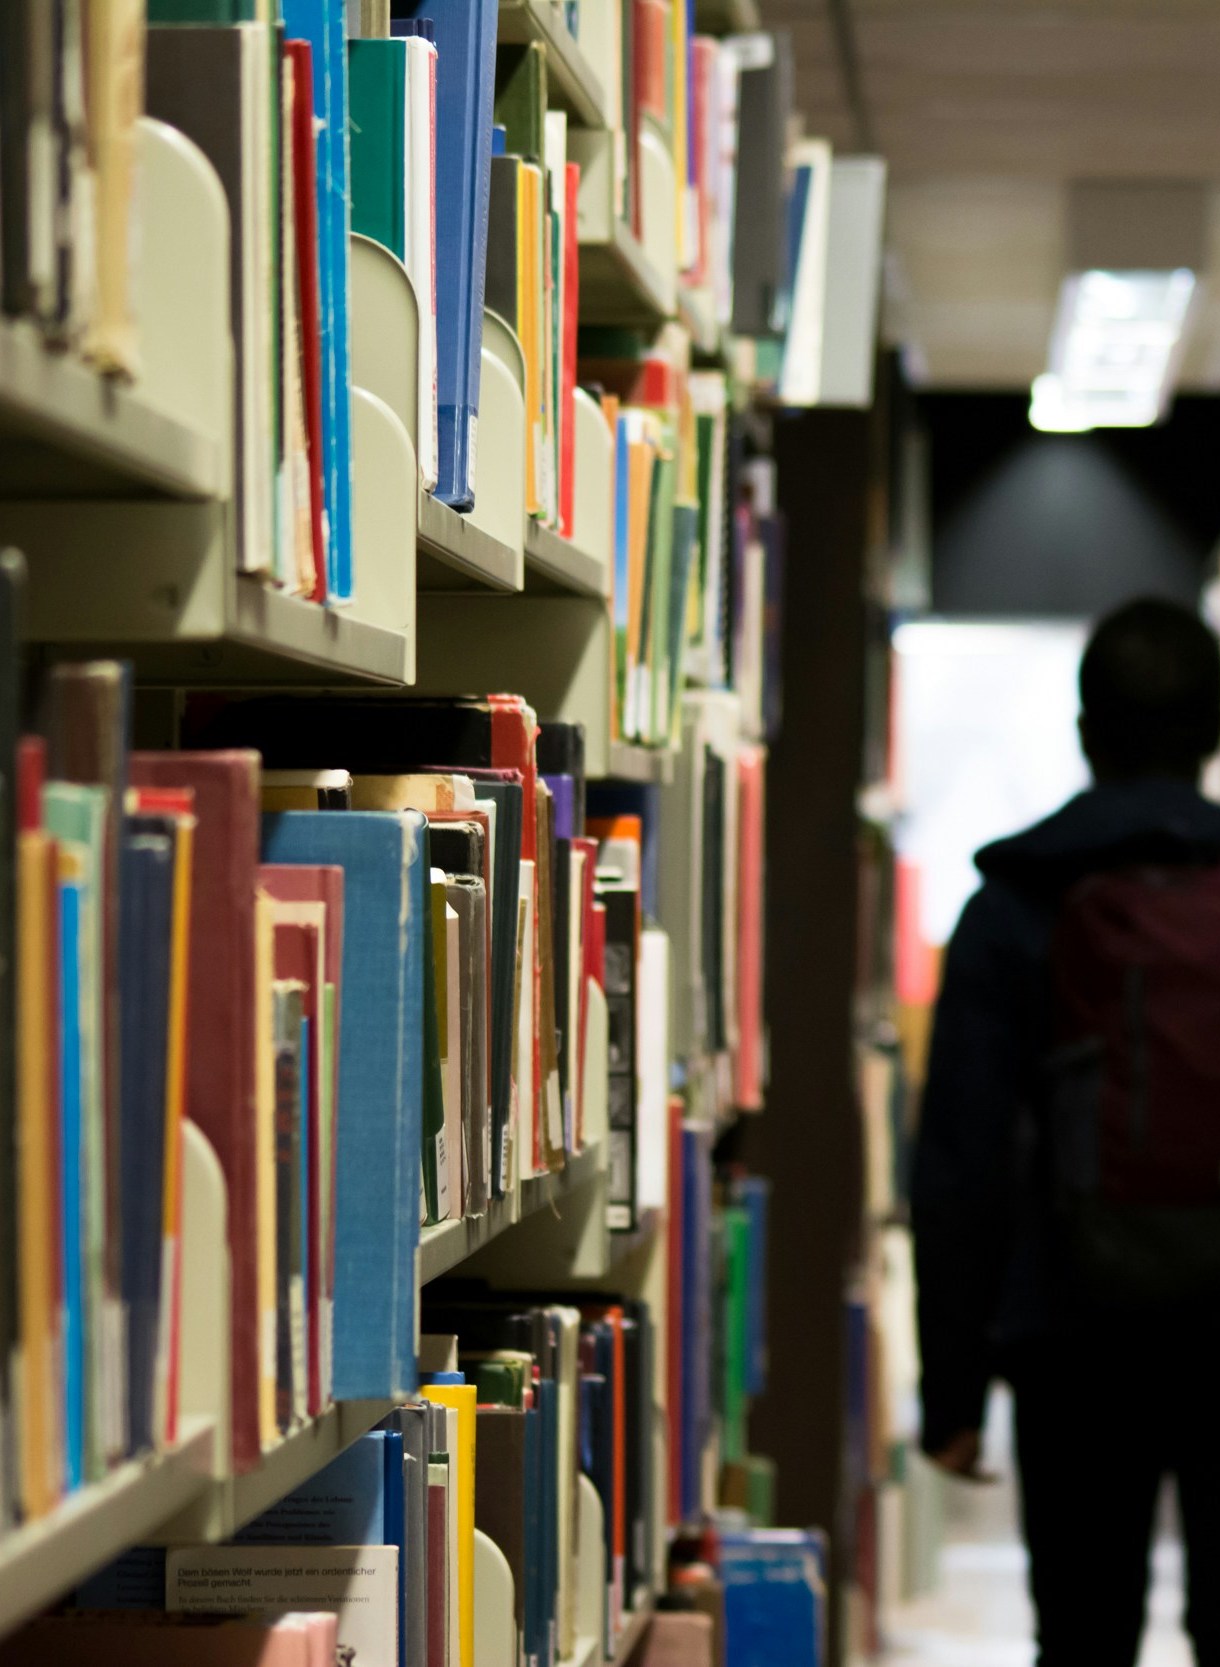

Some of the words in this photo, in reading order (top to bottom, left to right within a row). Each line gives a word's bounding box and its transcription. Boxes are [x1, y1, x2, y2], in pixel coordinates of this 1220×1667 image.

[178, 1567, 199, 1576] Dem
[201, 1567, 230, 1576] bösen
[232, 1567, 252, 1576] Wolf
[254, 1567, 283, 1576] wurde
[284, 1567, 303, 1578] jetzt
[305, 1567, 319, 1576] ein
[321, 1567, 376, 1576] ordentlicher
[217, 1594, 236, 1603] Buch
[238, 1594, 262, 1603] finden
[277, 1595, 288, 1603] die
